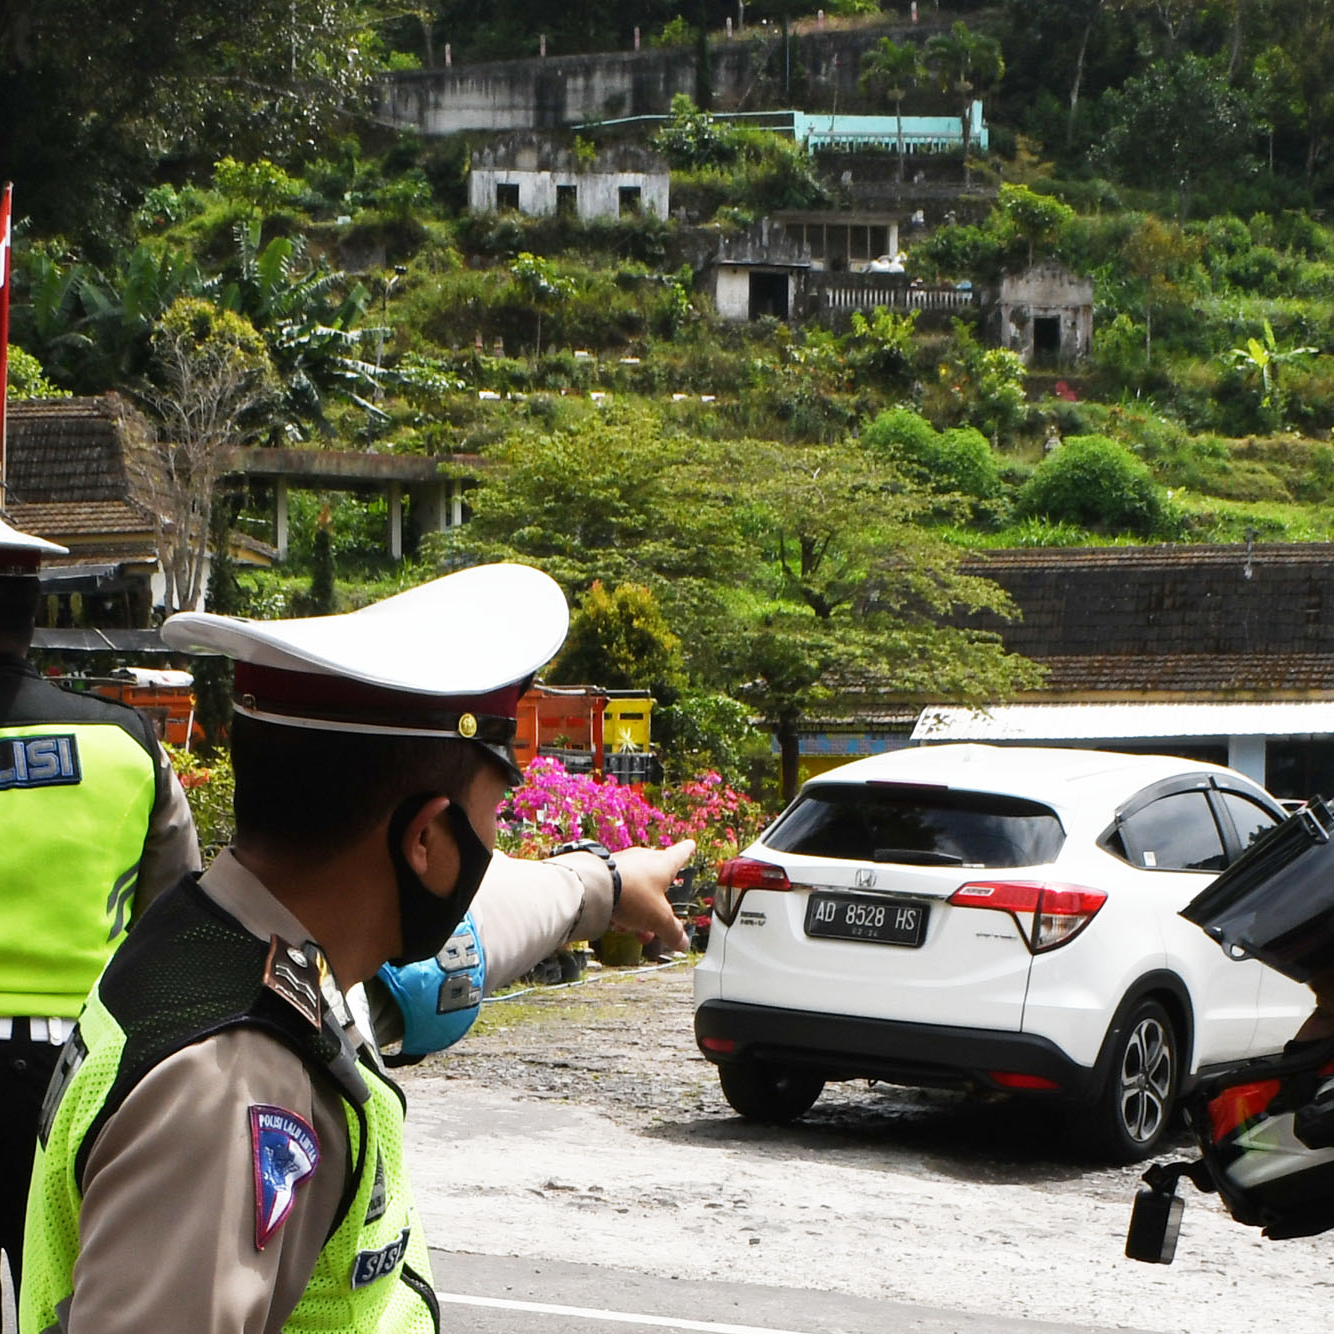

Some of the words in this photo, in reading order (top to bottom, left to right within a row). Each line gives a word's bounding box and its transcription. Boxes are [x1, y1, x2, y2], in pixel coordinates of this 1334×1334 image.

[816, 901, 836, 922] AD
[845, 904, 885, 927] 8528
[895, 908, 916, 930] HS
[258, 1114, 284, 1129] POLISI
[283, 1120, 302, 1139] LALU
